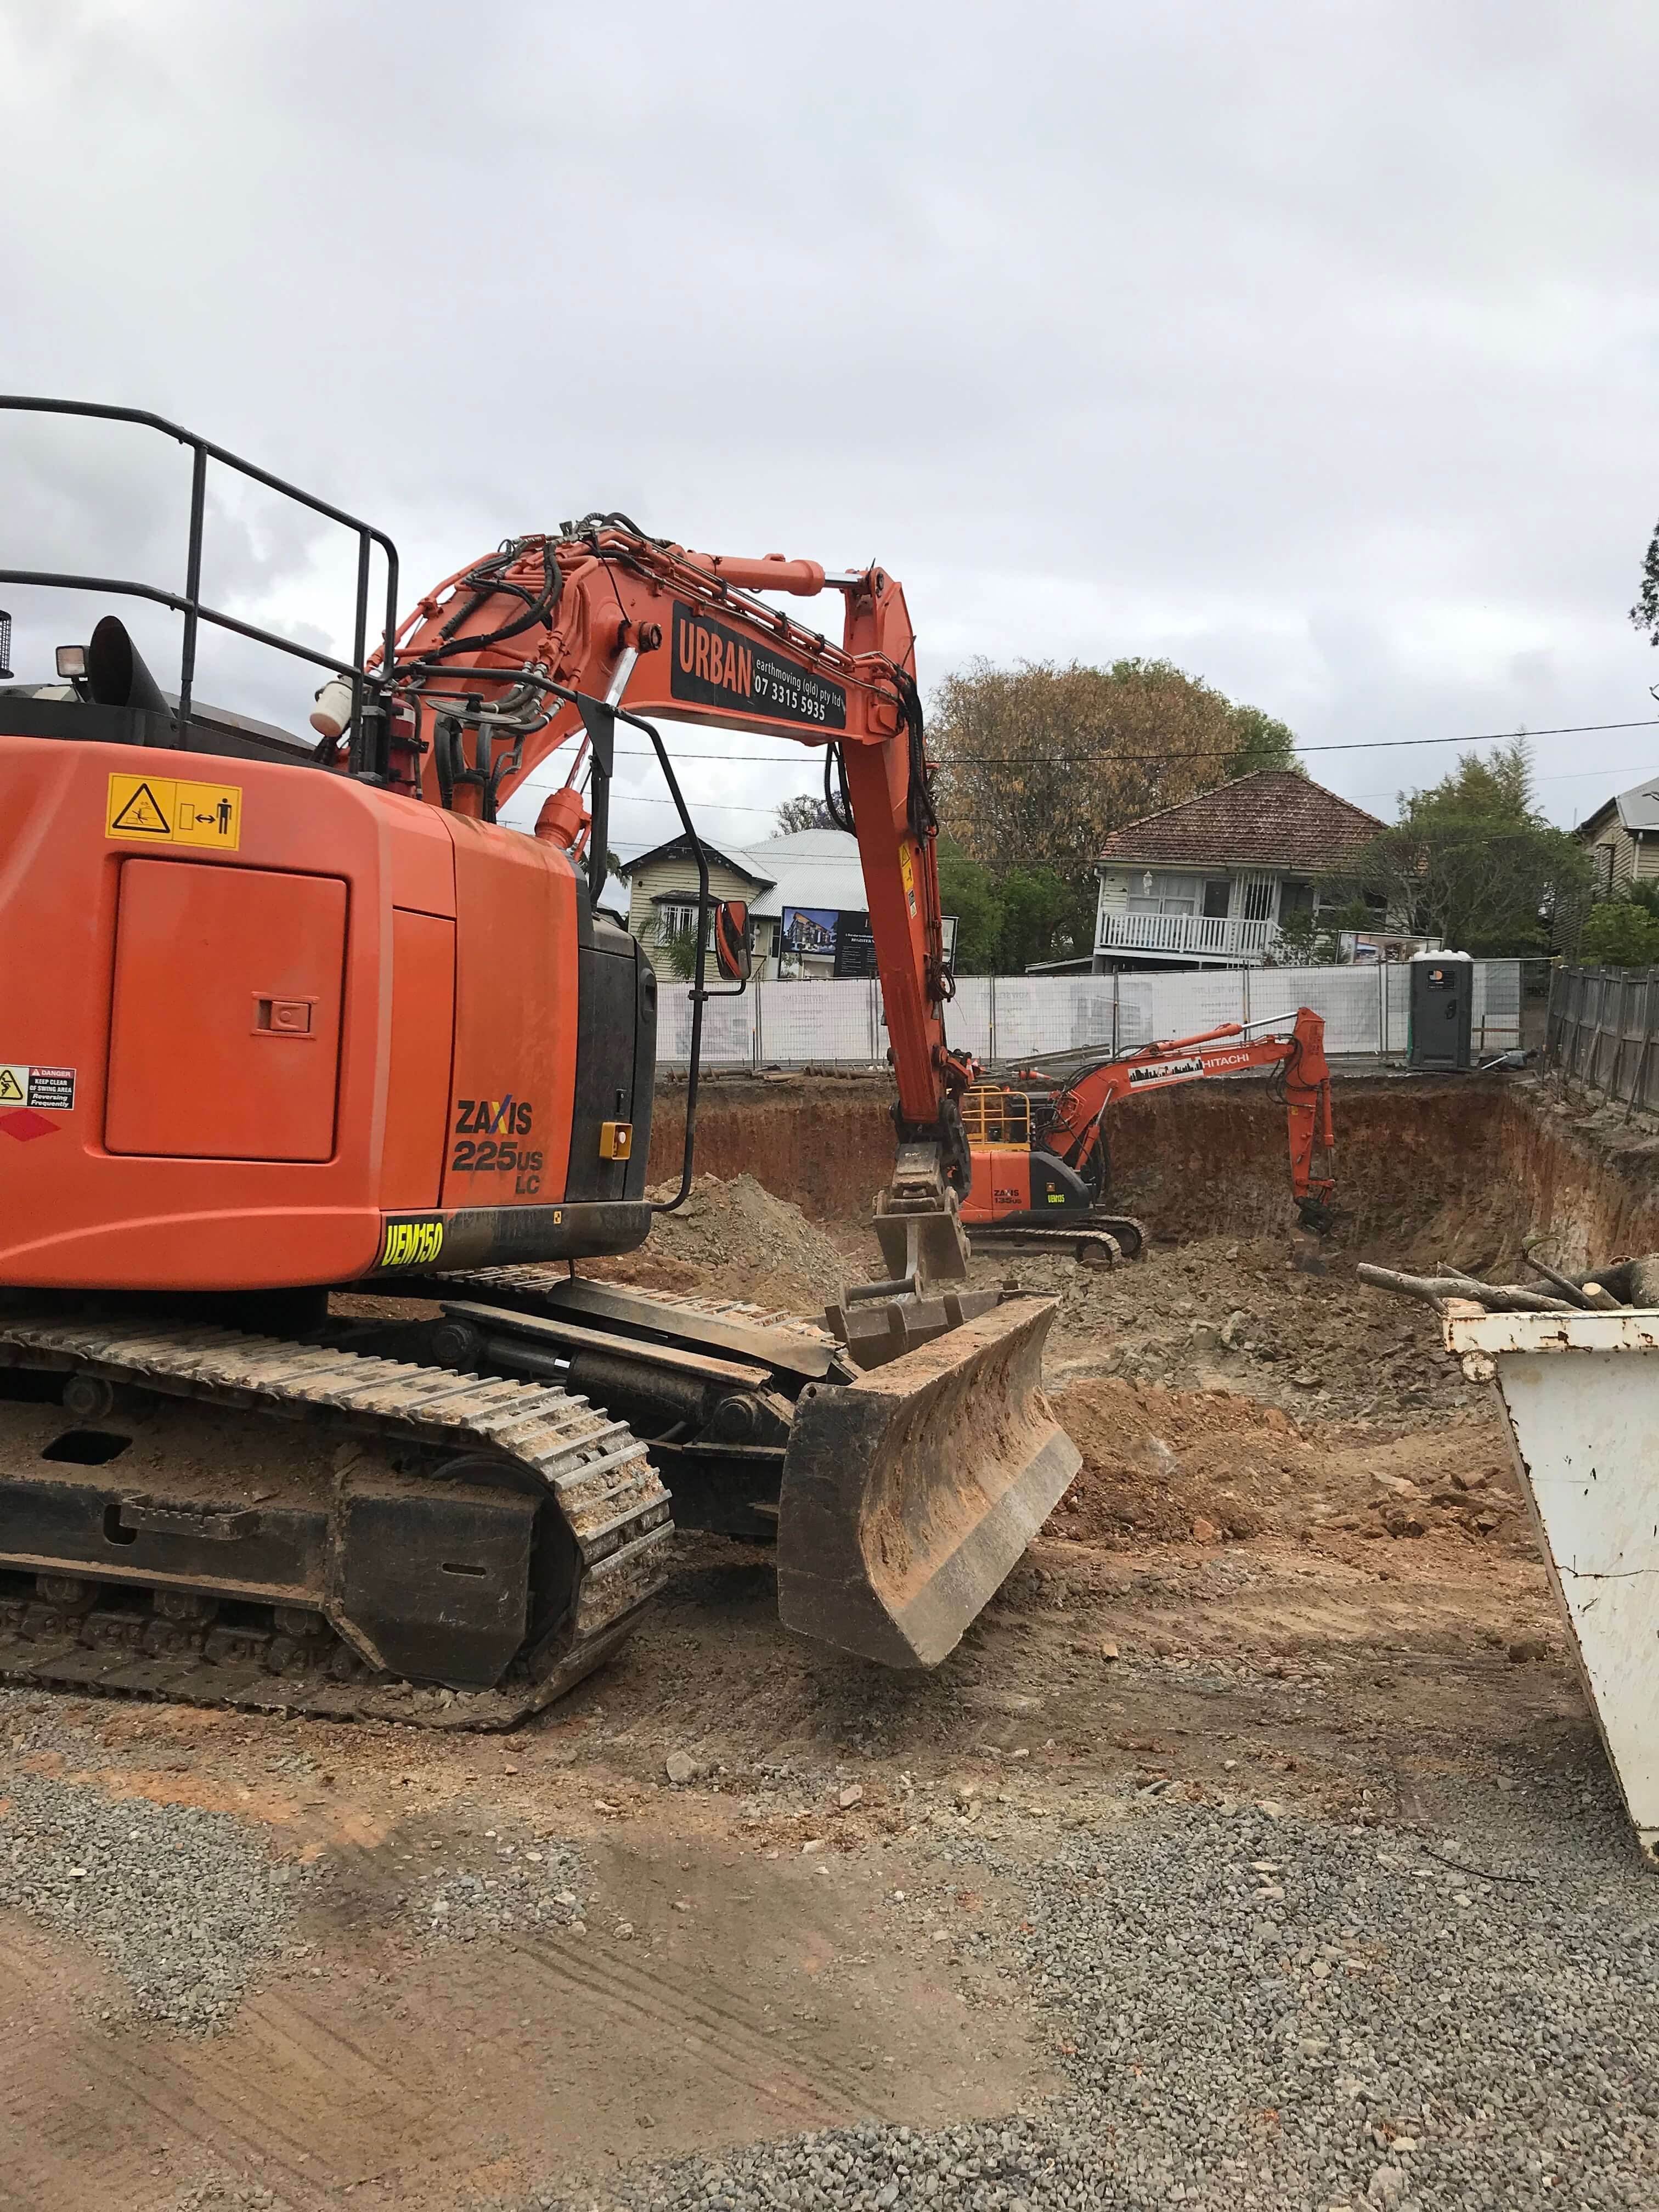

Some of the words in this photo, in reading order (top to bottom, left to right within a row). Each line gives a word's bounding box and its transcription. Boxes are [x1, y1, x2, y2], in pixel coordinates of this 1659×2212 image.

[680, 618, 752, 698] URBAN
[755, 675, 768, 696] 07
[771, 682, 797, 709] 3315
[800, 696, 825, 721] 5935
[756, 659, 801, 691] earthmoving
[803, 679, 818, 698] (qld)
[820, 690, 831, 705] pty
[832, 692, 841, 707] ltd
[1202, 1053, 1250, 1069] HITACHI
[32, 1093, 68, 1102] Reversing
[456, 1094, 532, 1135] ZAXIS
[515, 1175, 540, 1194] LC
[381, 1222, 443, 1266] UEM150
